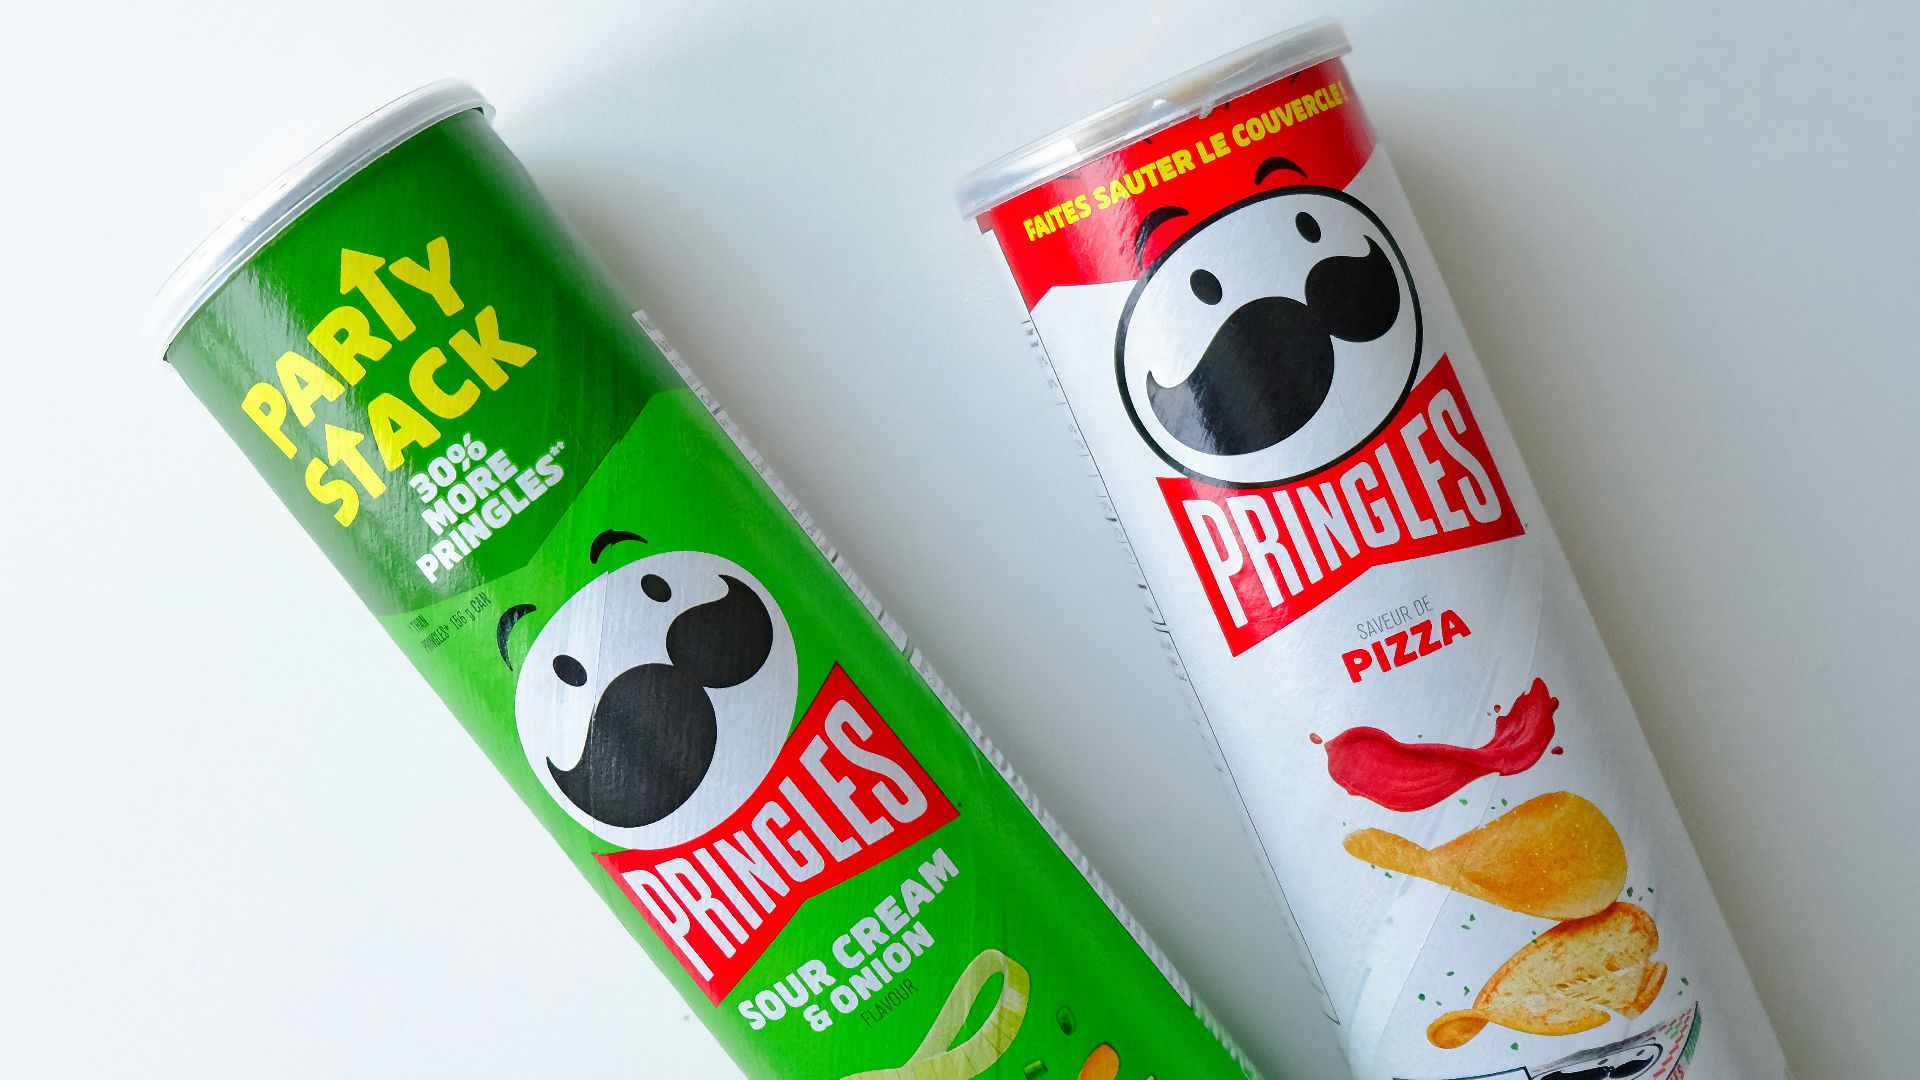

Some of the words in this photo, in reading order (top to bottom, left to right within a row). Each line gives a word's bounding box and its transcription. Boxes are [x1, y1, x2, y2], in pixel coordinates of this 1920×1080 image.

[1023, 195, 1092, 242] FAITES
[1092, 149, 1196, 210] SAUTER
[1195, 132, 1231, 164] LE
[241, 236, 465, 460] PARTY
[304, 304, 537, 527] STACK
[409, 432, 488, 504] 30%
[421, 448, 520, 536] MORE
[1181, 388, 1502, 629] PRINGLES
[449, 610, 468, 630] 156
[464, 608, 476, 621] g
[469, 591, 492, 613] CAN
[1341, 609, 1472, 683] PIZZA
[1356, 605, 1413, 640] SAVEUR
[1413, 594, 1434, 617] DE
[620, 699, 928, 982] PRINGLES
[737, 959, 837, 1031] SOUR
[832, 847, 960, 969] CREAM
[802, 1004, 834, 1032] &
[829, 920, 935, 1014] ONION
[859, 978, 918, 1028] FLAVOUR
